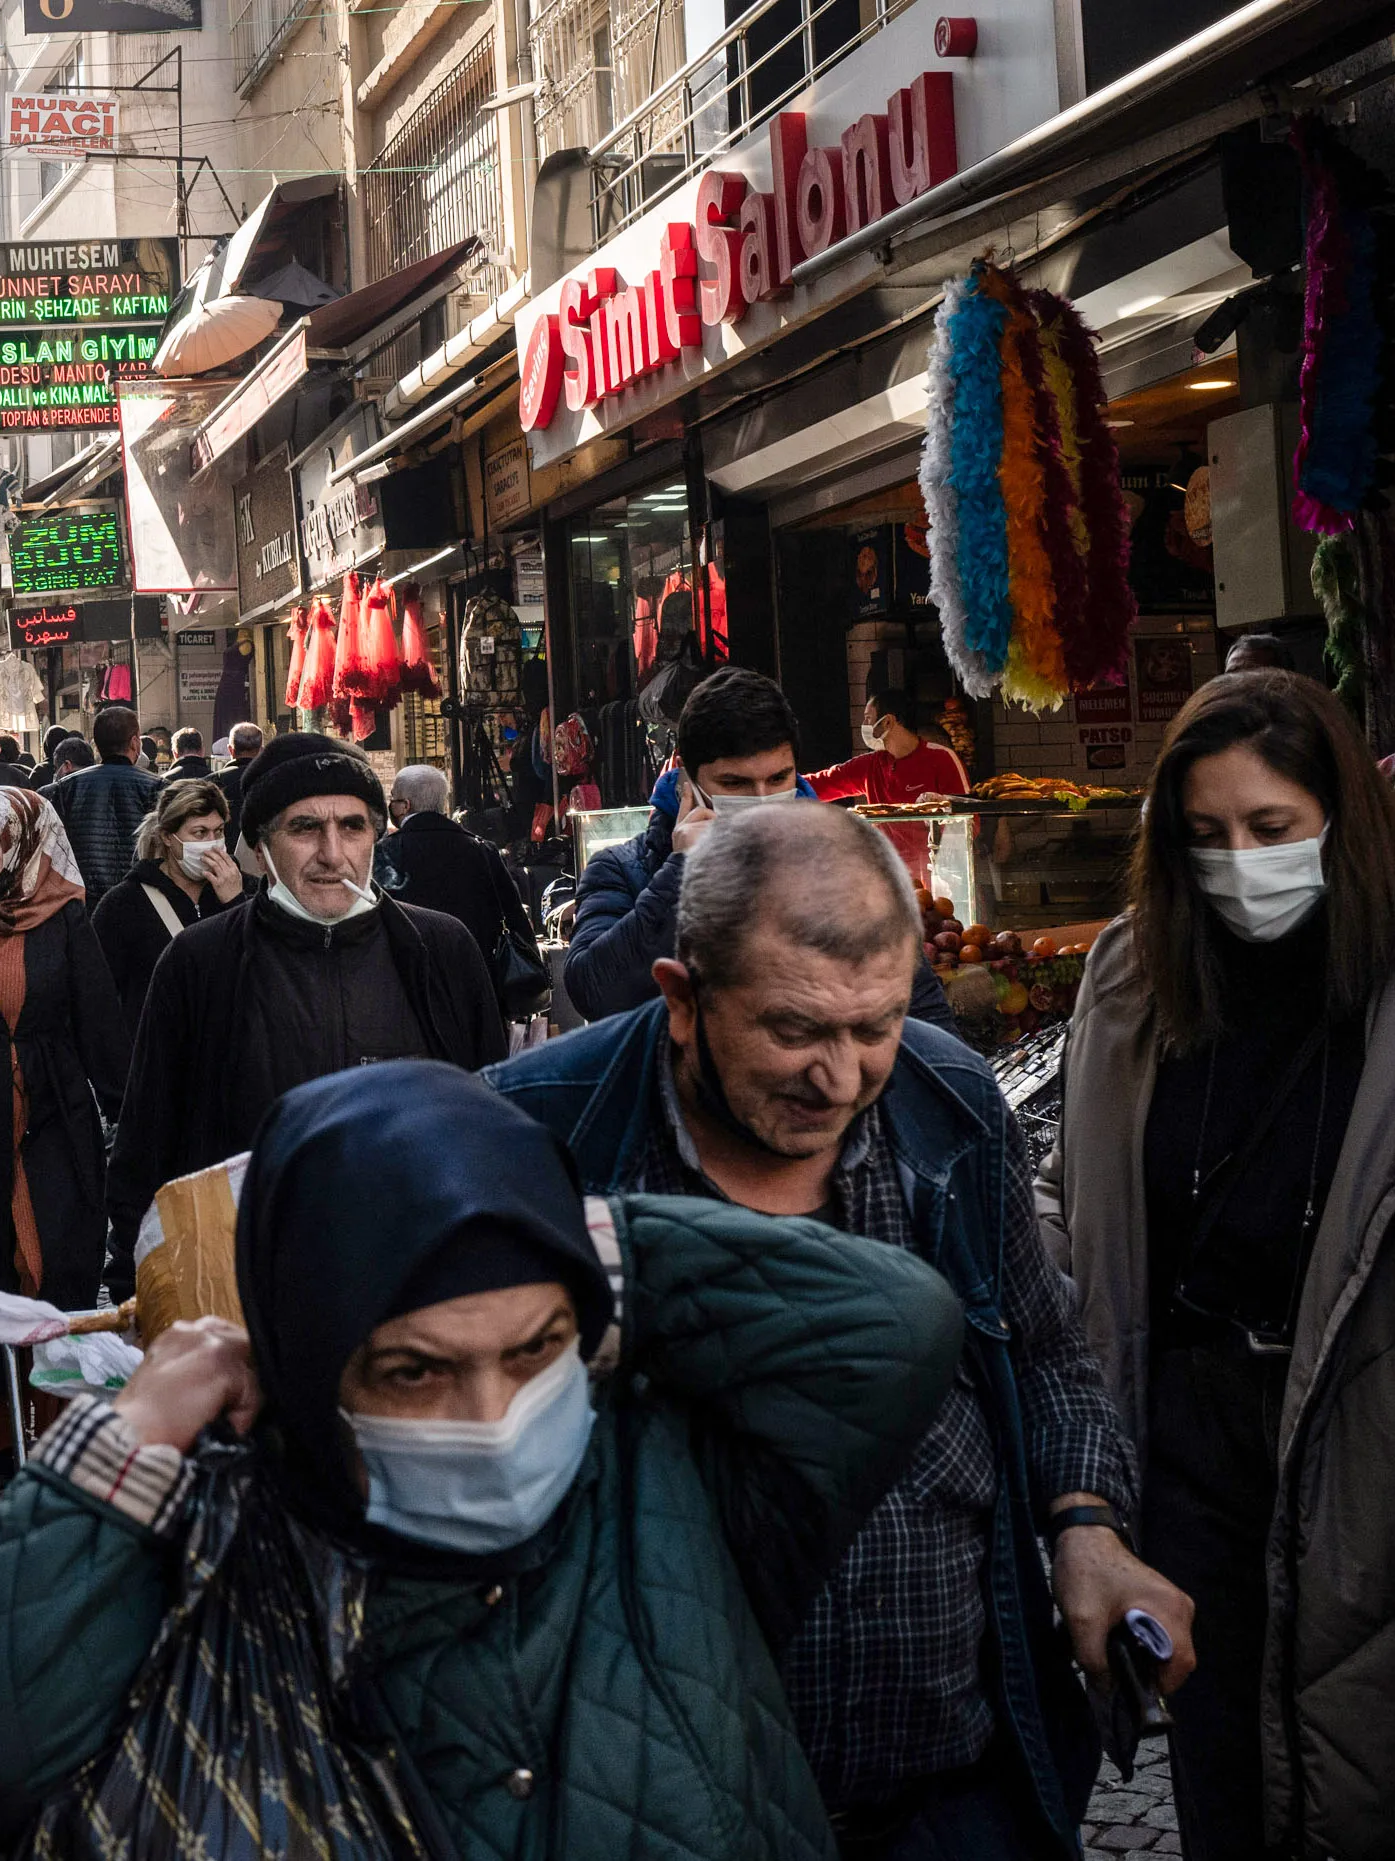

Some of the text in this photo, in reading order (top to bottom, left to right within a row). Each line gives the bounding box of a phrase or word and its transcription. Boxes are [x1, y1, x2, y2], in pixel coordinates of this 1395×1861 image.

[11, 97, 116, 114] MURAT
[10, 111, 114, 137] HACI
[696, 71, 958, 327] Salonu
[9, 244, 120, 272] MUHTEŞEM
[68, 274, 141, 295] SARAYI
[113, 296, 168, 315] KAFTAN
[81, 334, 156, 361] GİYİM
[53, 363, 106, 383] MANTO
[32, 391, 47, 405] ve
[50, 386, 80, 405] KINA
[1, 409, 40, 427] TOPTAN
[51, 408, 111, 426] PERAKENDE
[261, 530, 292, 574] KUBİLAY
[179, 633, 214, 644] TİCARET
[1079, 727, 1133, 744] PATSO
